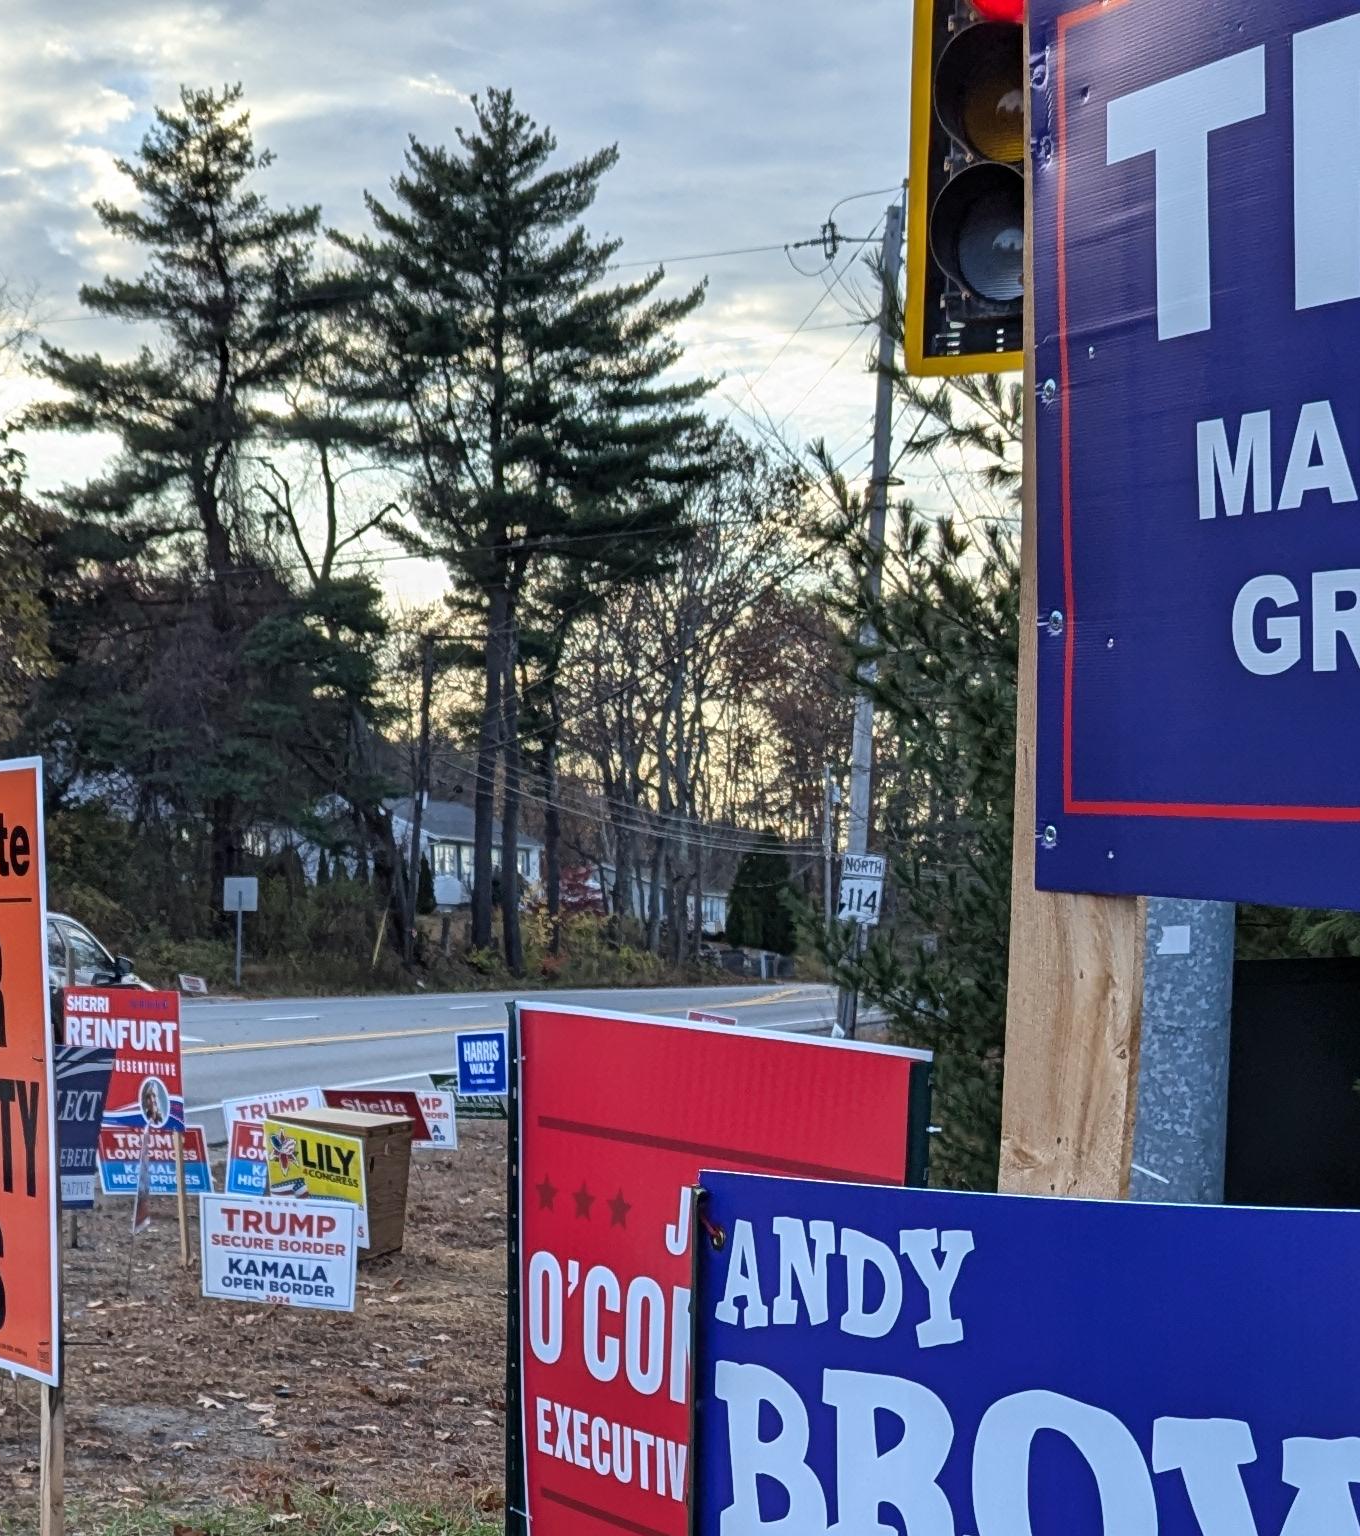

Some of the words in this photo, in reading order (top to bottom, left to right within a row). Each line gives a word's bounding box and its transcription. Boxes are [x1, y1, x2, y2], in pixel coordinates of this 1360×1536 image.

[845, 856, 882, 873] NORTH
[848, 887, 878, 914] 114
[66, 995, 110, 1013] SHERRI
[66, 1016, 177, 1053] REINFURT
[463, 1040, 500, 1062] HARRIS
[469, 1062, 495, 1075] WALZ
[236, 1096, 309, 1120] TRUMP
[341, 1097, 407, 1114] Sheila
[301, 1139, 356, 1177] LILY
[220, 1207, 336, 1239] TRUMP
[211, 1233, 274, 1252] SECURE
[278, 1239, 346, 1257] BORDER
[228, 1257, 328, 1283] KAMALA
[714, 1216, 974, 1348] ANDY
[221, 1275, 265, 1292] OPEN
[269, 1280, 335, 1298] BORDER
[265, 1294, 290, 1304] 2024
